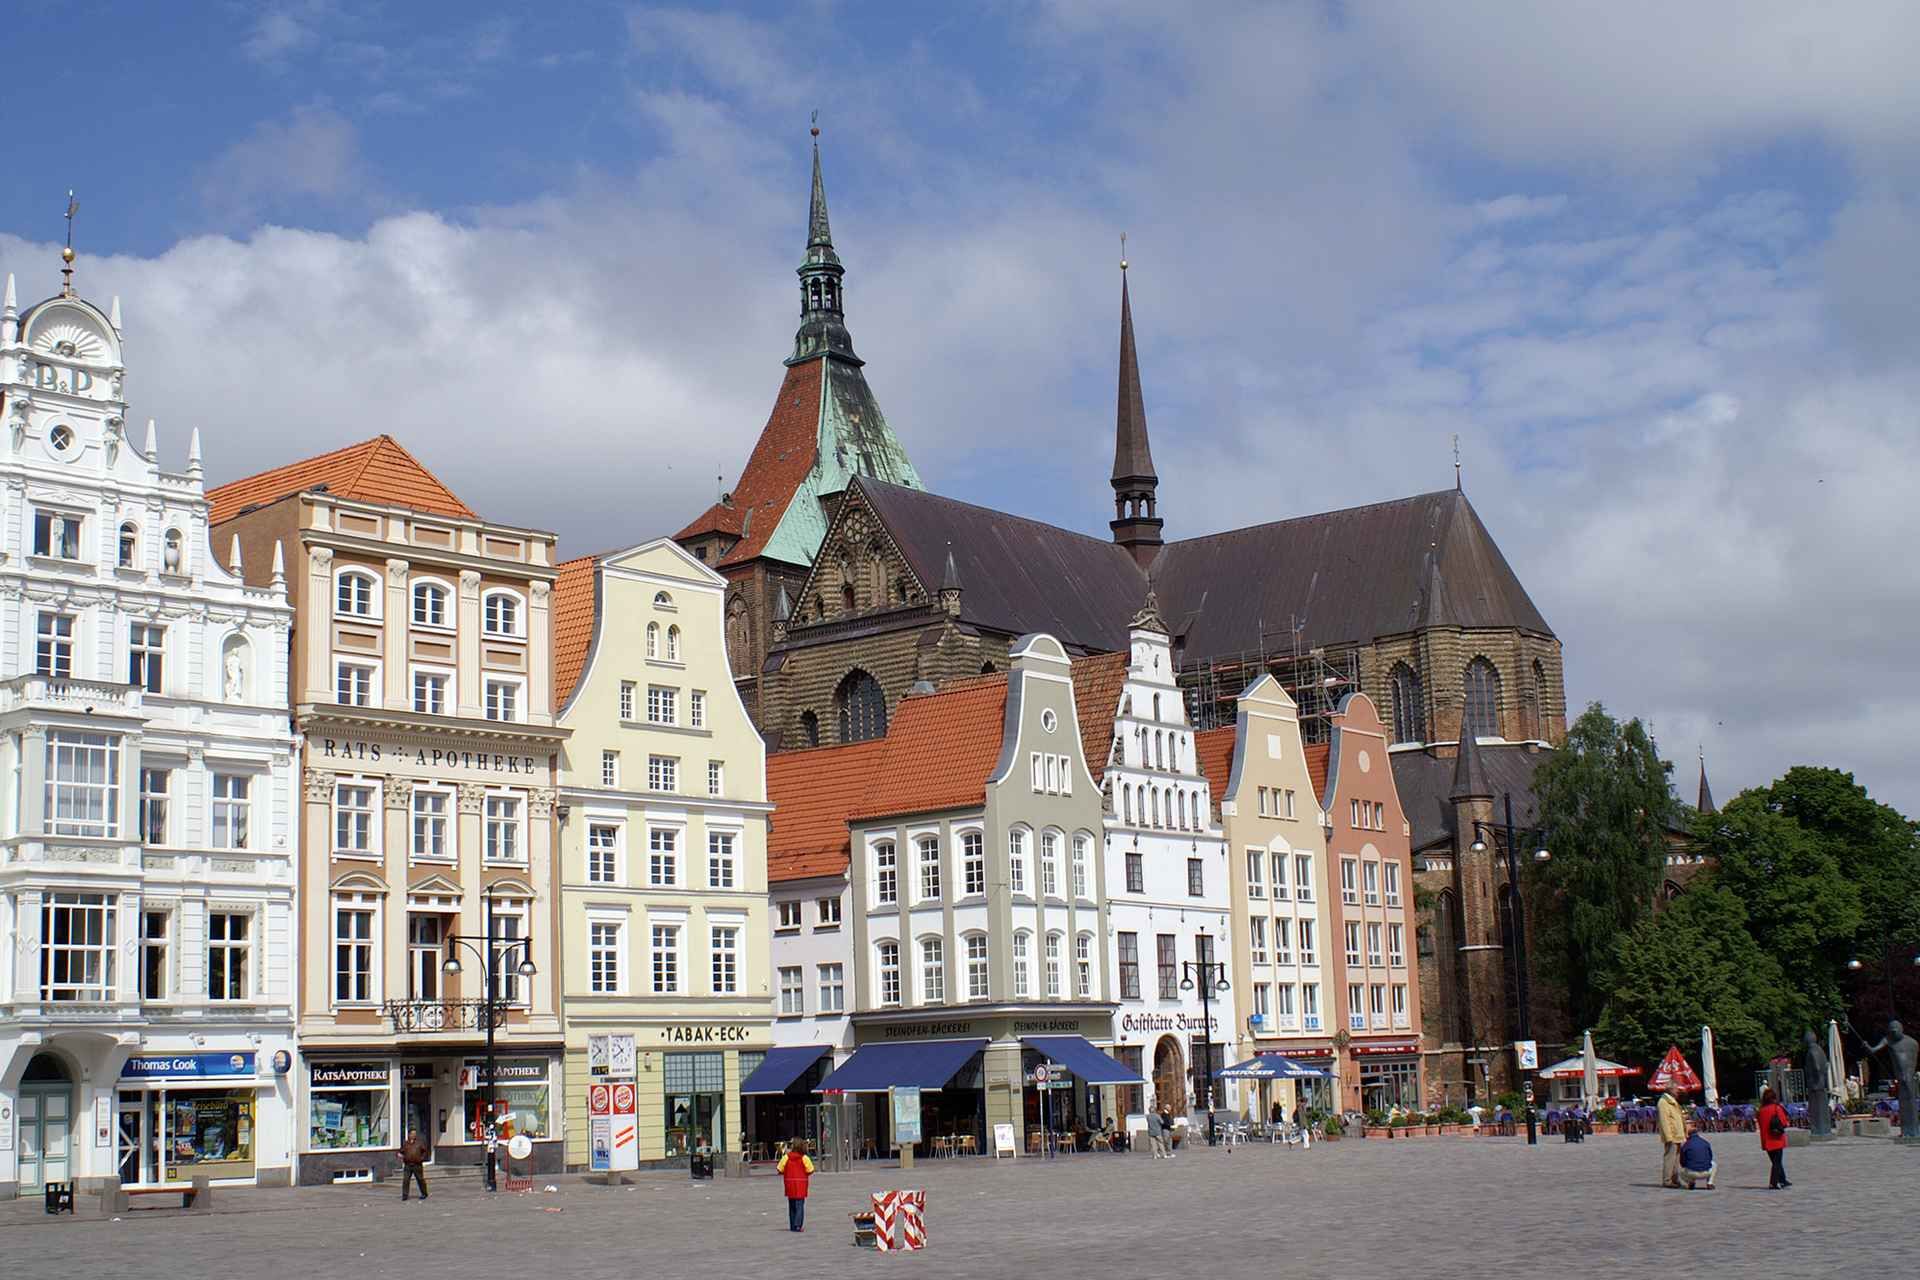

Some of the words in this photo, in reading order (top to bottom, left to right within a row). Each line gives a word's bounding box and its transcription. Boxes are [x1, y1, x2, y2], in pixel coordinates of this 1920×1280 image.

[323, 738, 382, 762] RATS
[415, 748, 536, 775] APOTHEKE
[1176, 1013, 1218, 1032] Burwtz
[131, 1059, 169, 1071] Thomas
[172, 1059, 197, 1070] Cook
